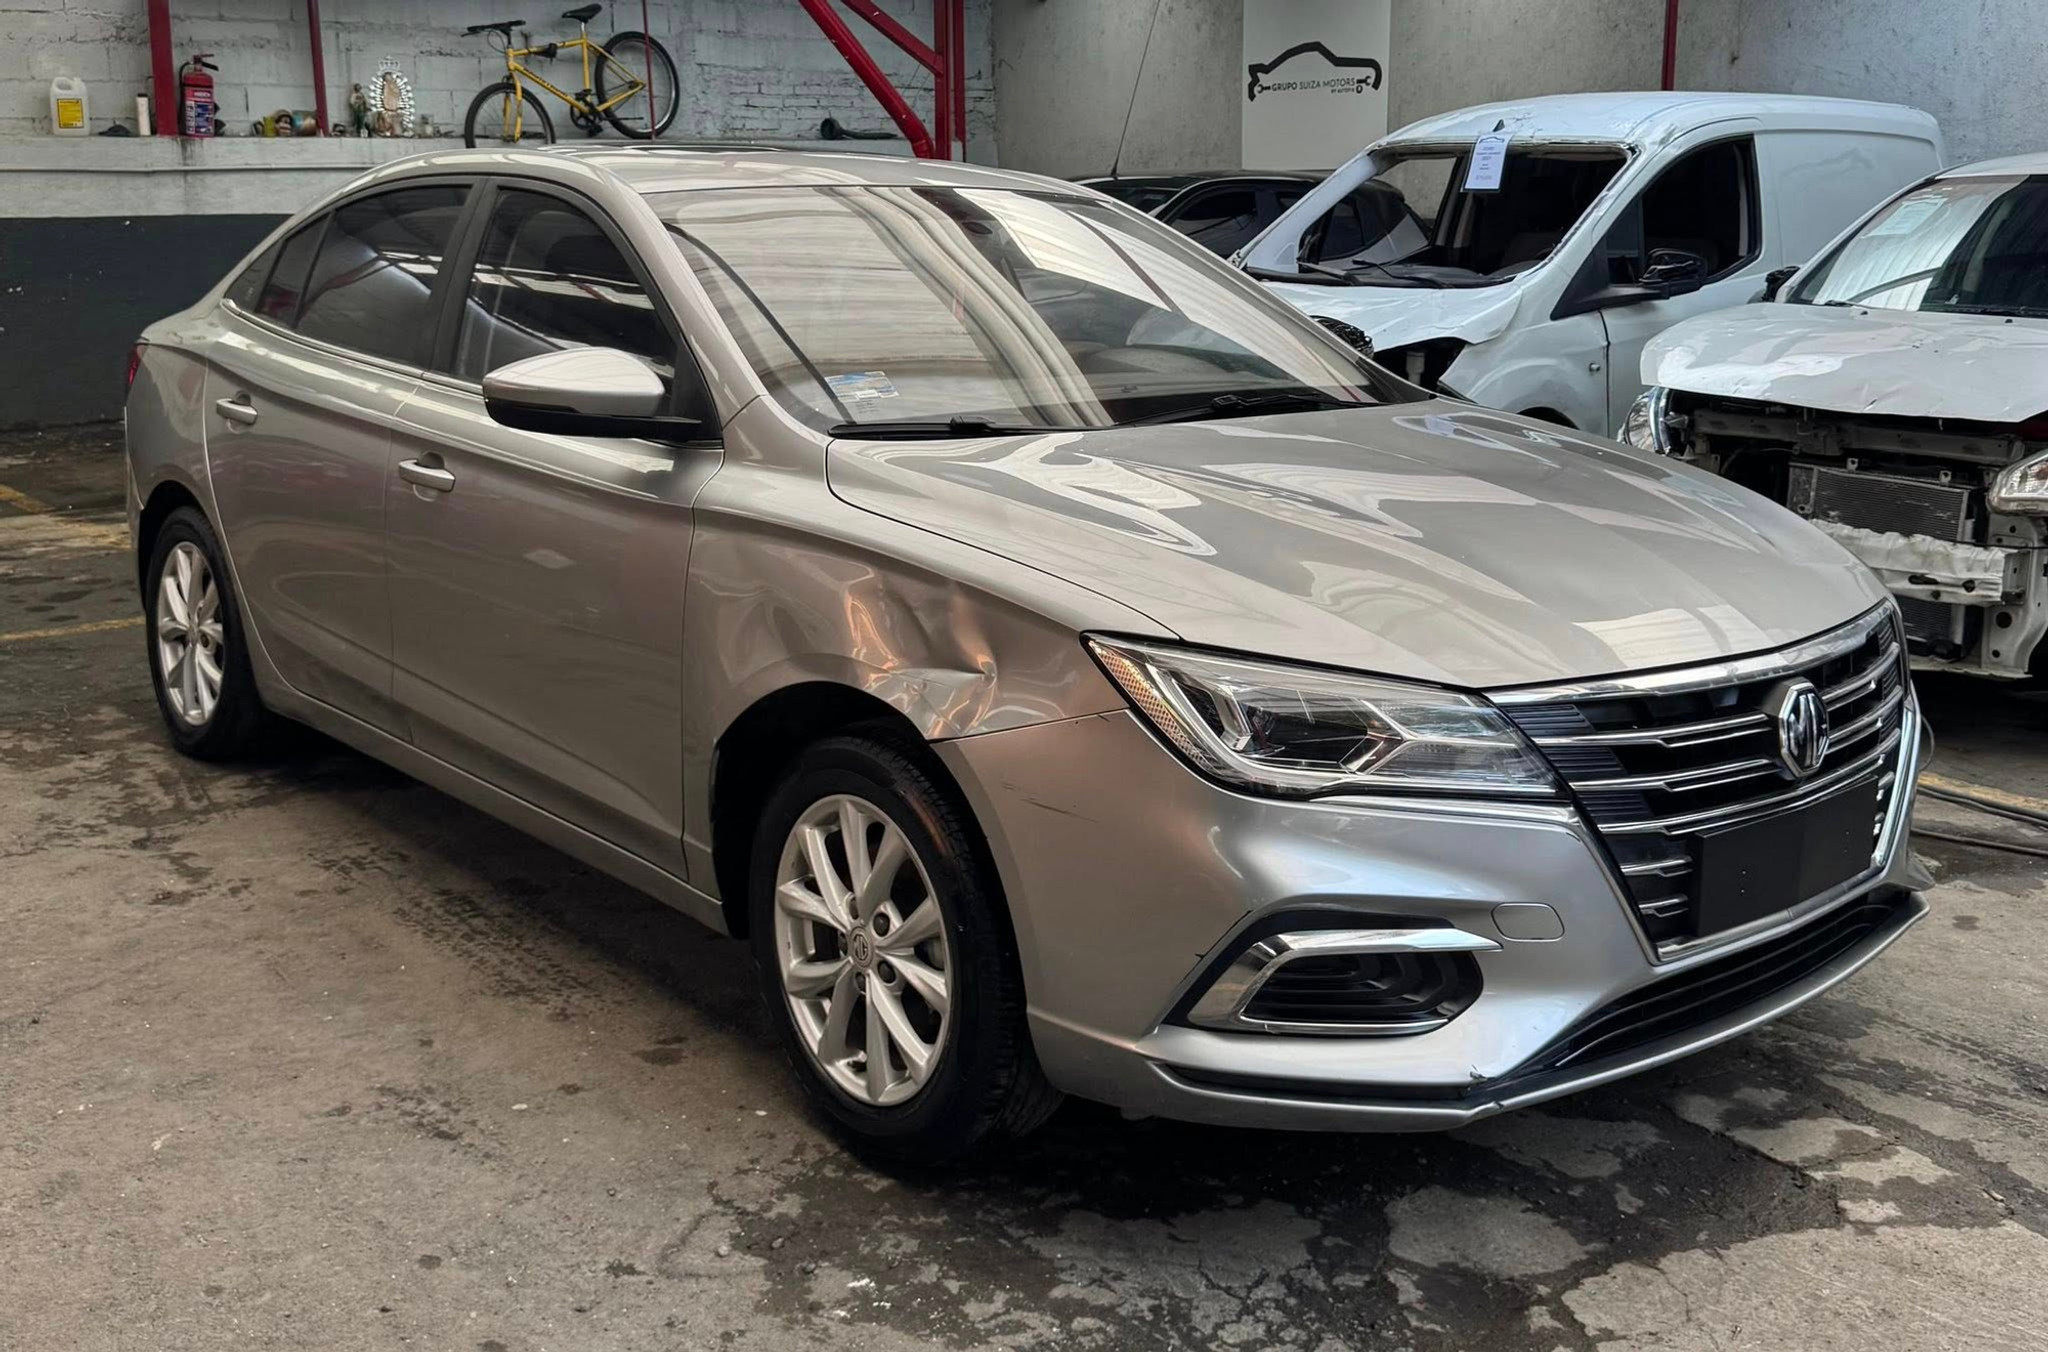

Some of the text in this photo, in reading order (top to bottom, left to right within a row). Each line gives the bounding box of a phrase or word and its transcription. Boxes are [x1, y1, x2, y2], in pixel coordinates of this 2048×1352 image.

[1271, 77, 1355, 91] GRUPO SUIZA MOTORS
[853, 933, 869, 961] MG
